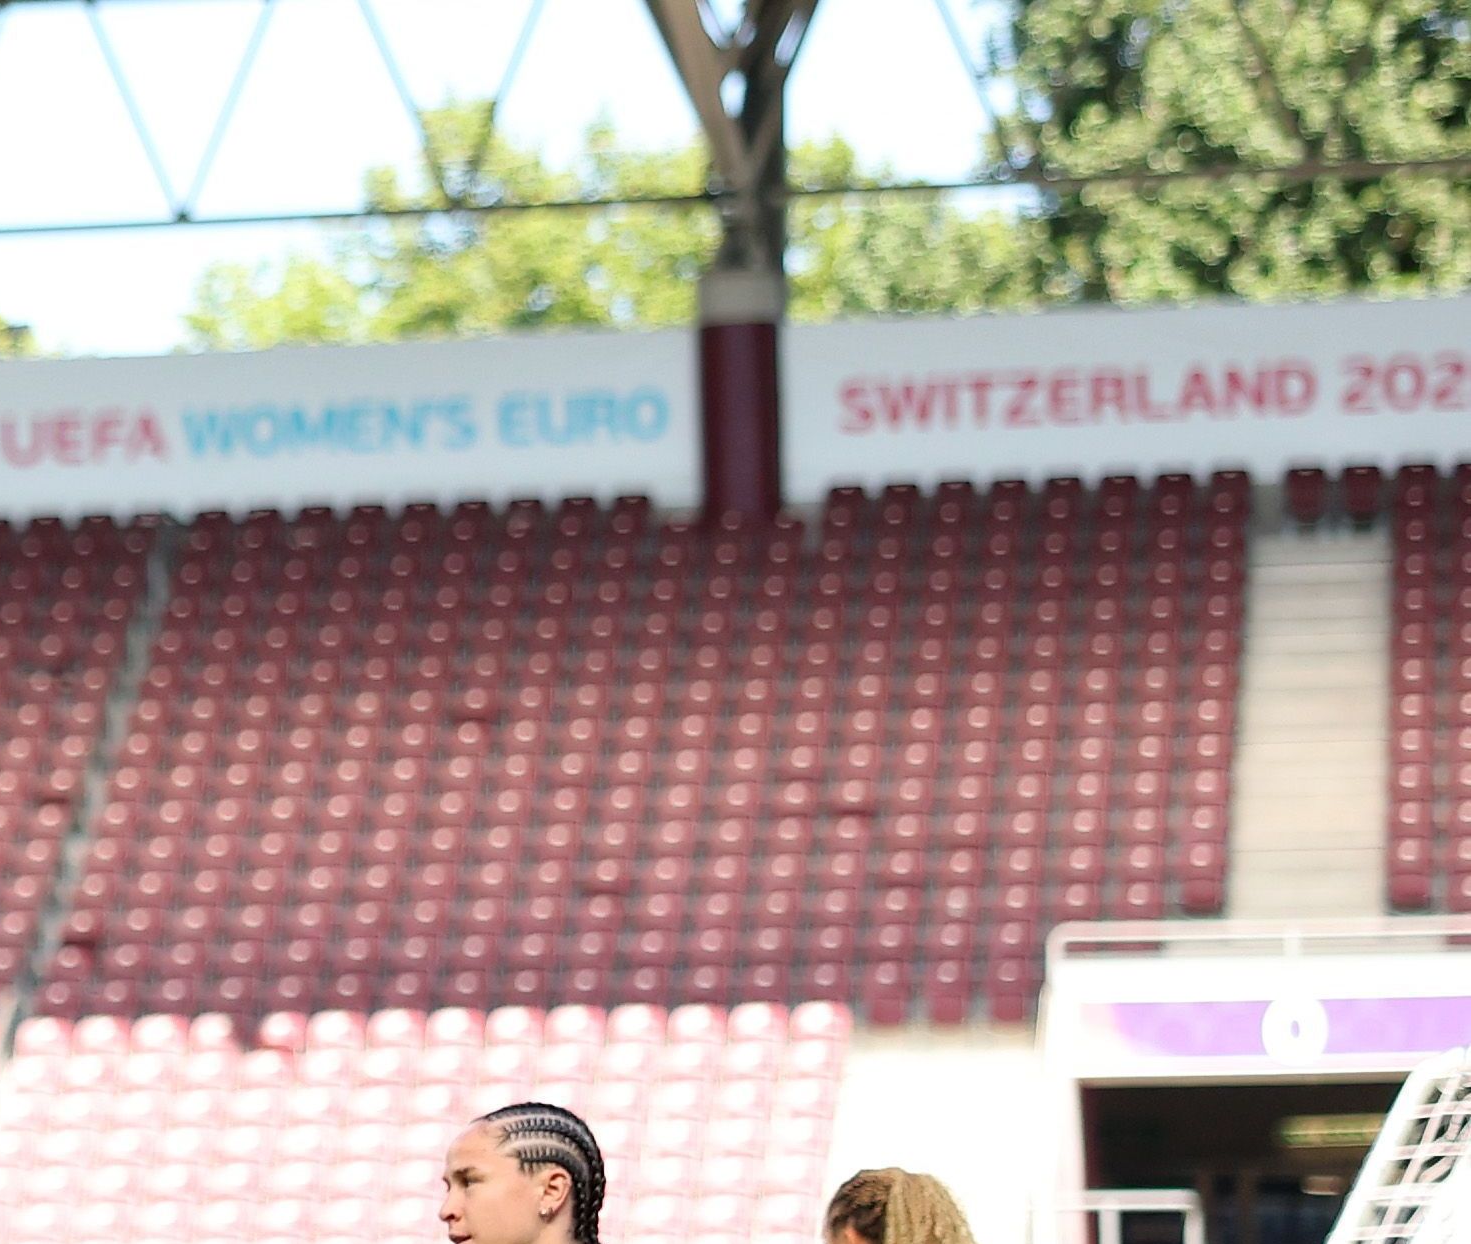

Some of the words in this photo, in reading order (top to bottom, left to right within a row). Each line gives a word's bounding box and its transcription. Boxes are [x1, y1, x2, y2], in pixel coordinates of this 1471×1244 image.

[184, 395, 474, 459] WOMEN'S
[496, 386, 670, 447] EURO
[837, 357, 1318, 434] SWITZERLAND
